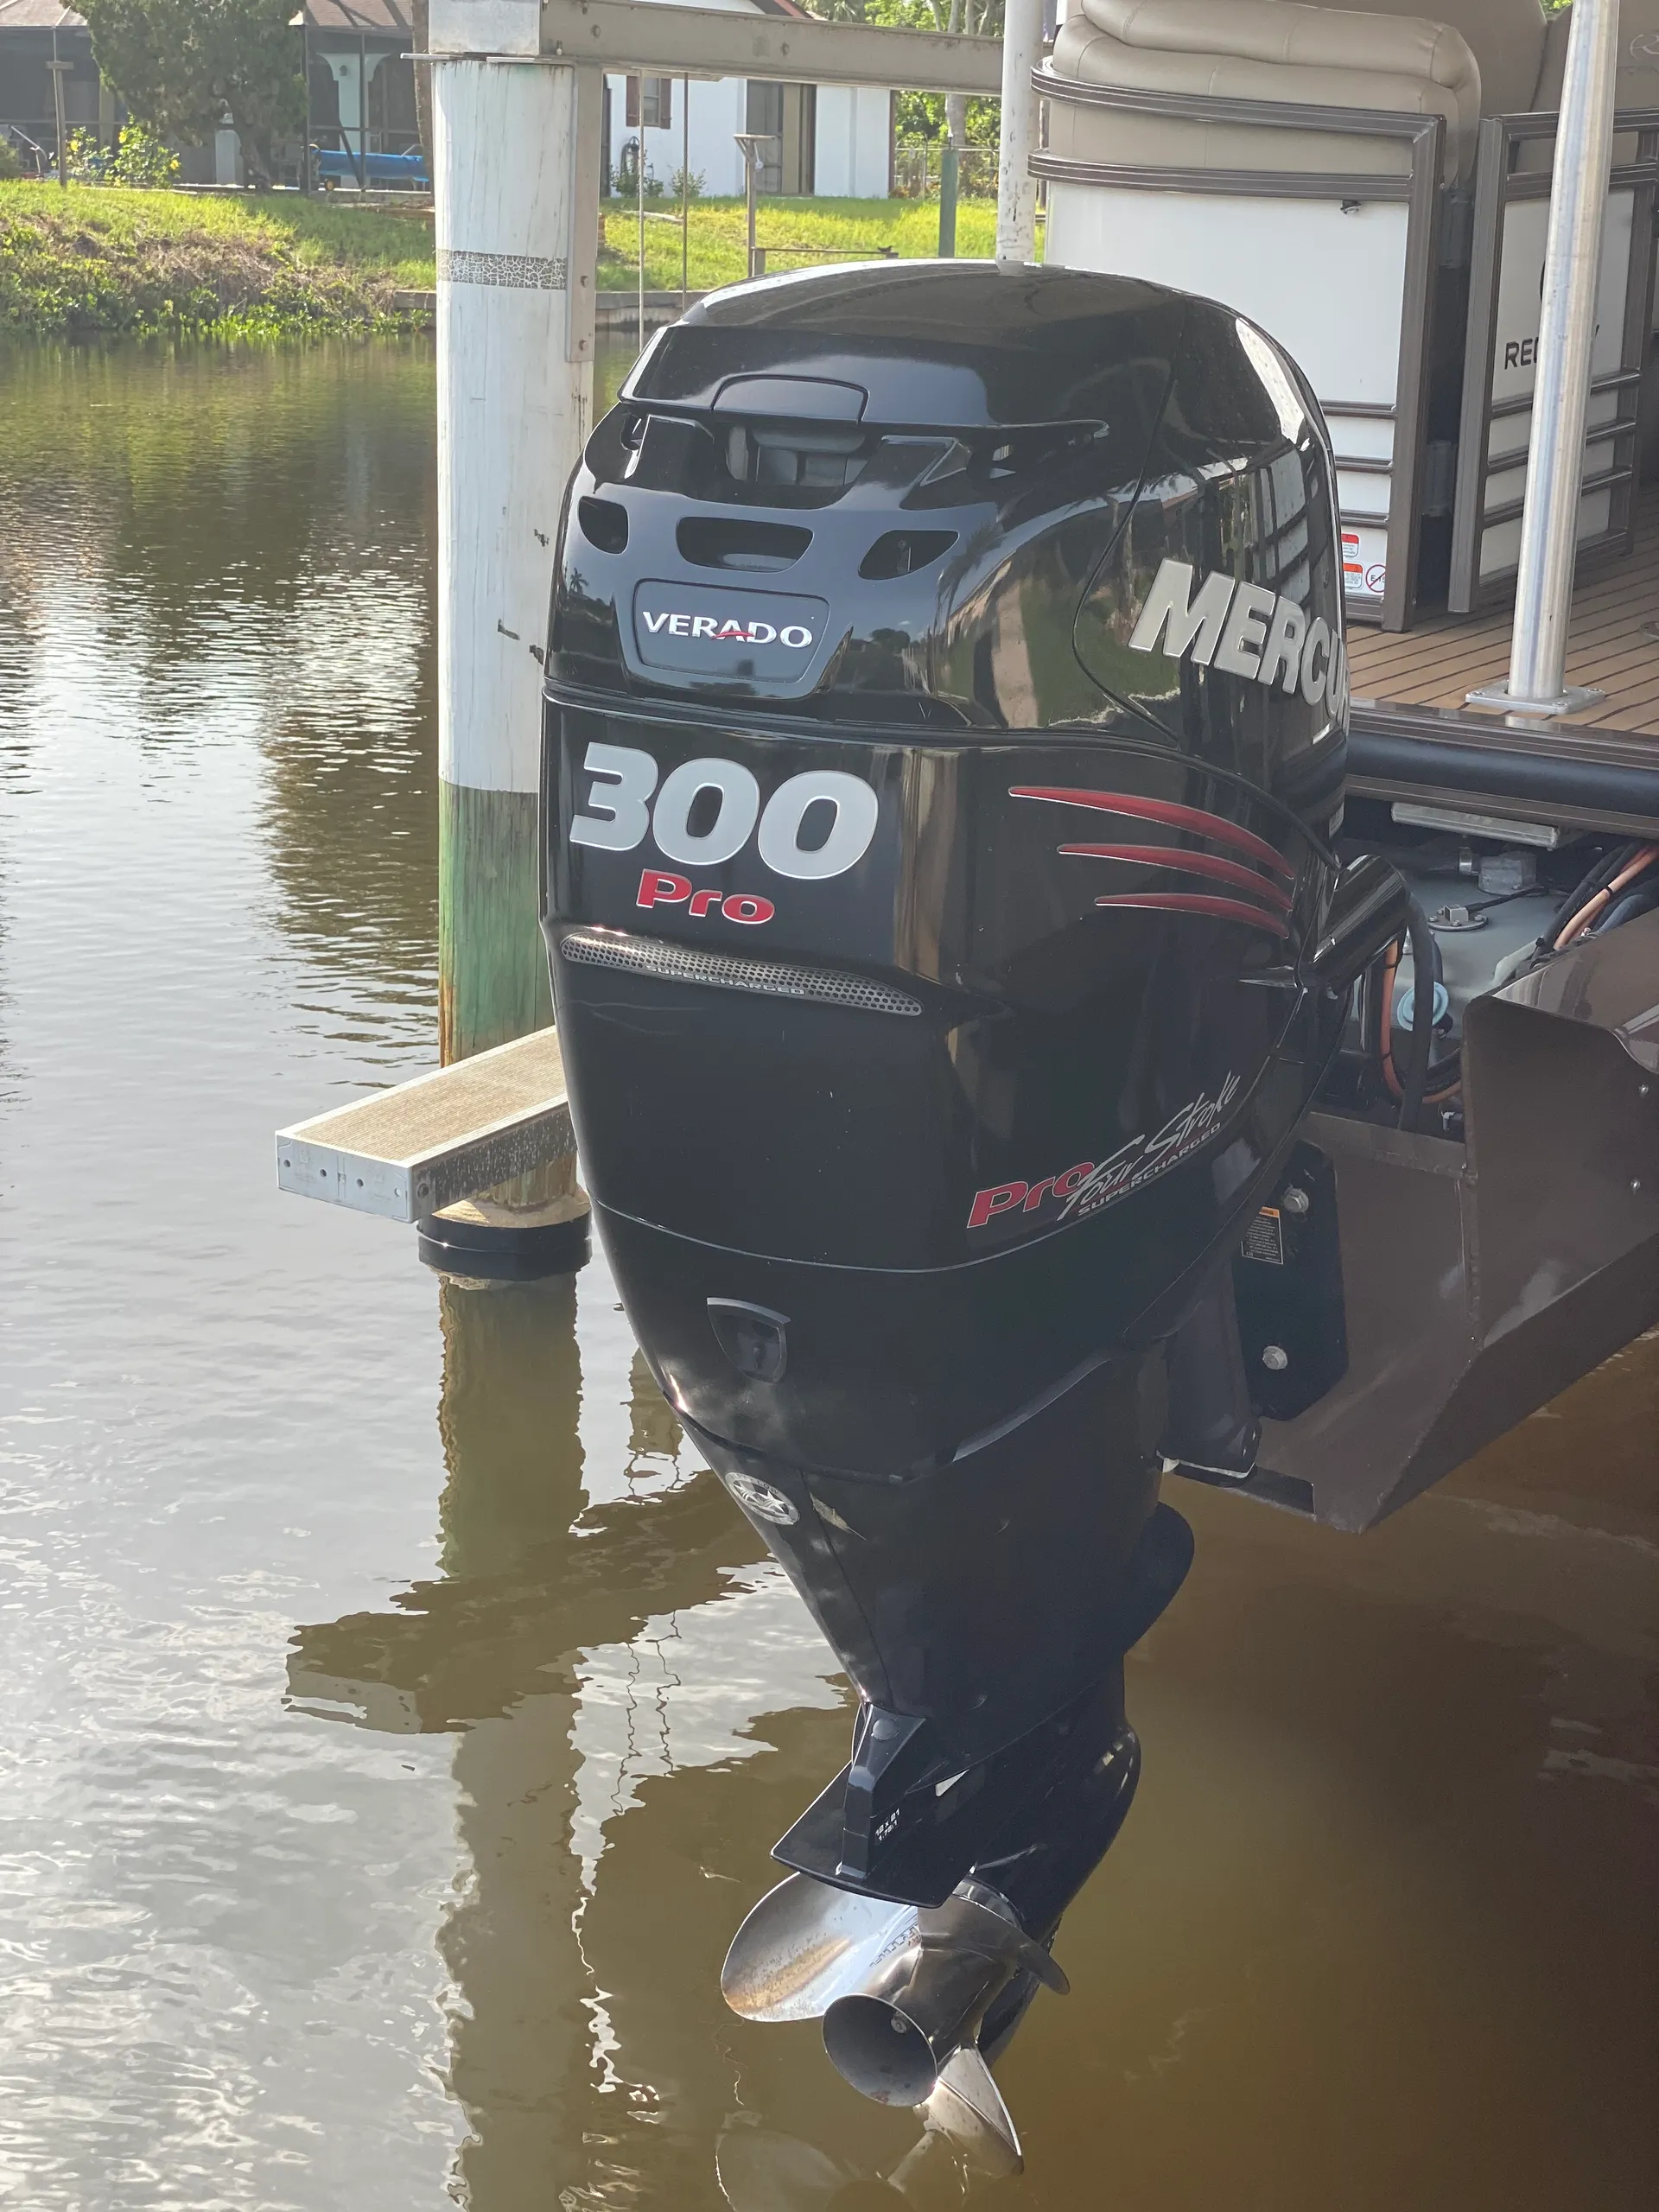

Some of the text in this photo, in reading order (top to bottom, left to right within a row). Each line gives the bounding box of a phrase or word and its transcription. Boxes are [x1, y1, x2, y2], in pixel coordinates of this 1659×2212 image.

[642, 611, 813, 648] VERADO
[569, 741, 879, 880] 300
[636, 868, 775, 925] Pro
[646, 965, 804, 995] SUPERCHARGED
[967, 1161, 1095, 1229] Pro
[1078, 1122, 1221, 1216] SUPERCHARGED
[757, 1480, 779, 1495] LOW
